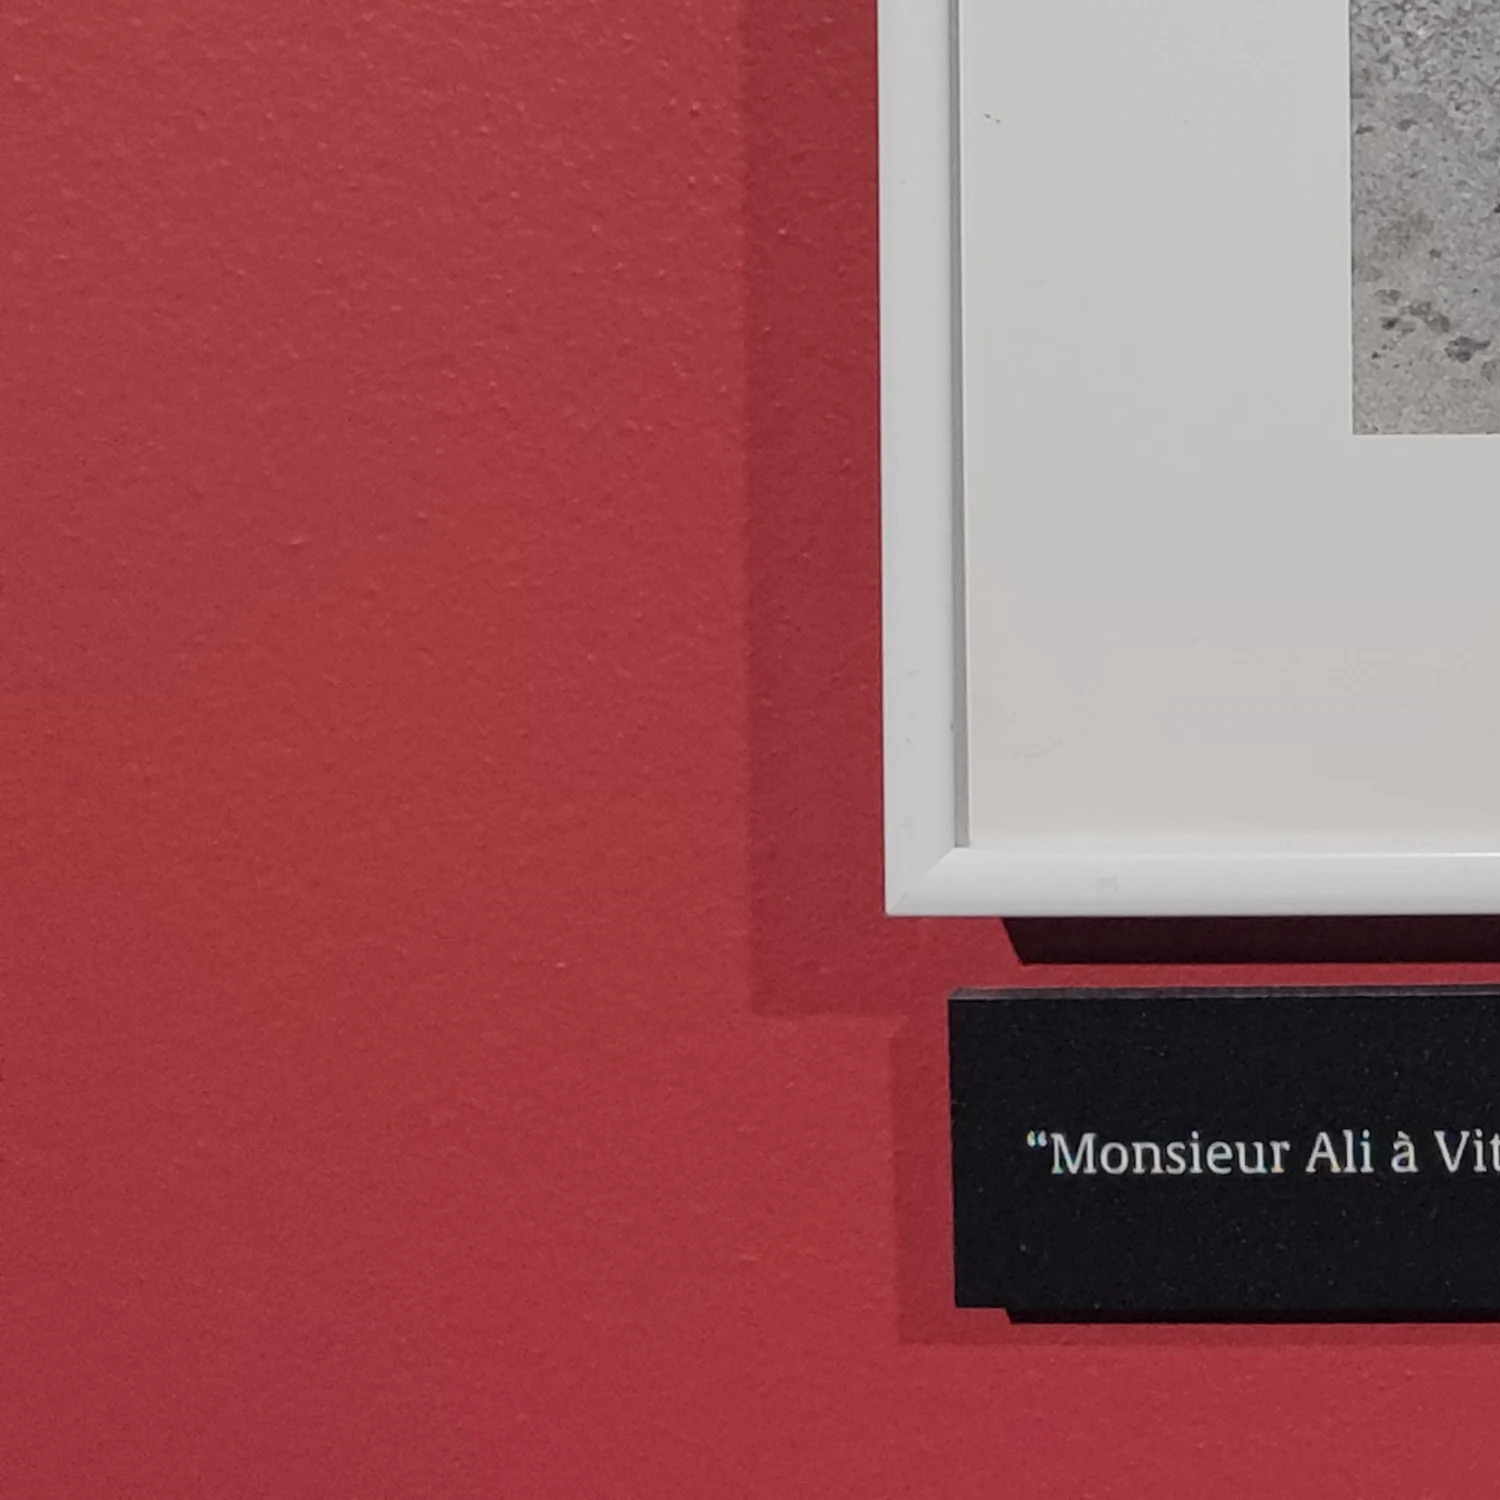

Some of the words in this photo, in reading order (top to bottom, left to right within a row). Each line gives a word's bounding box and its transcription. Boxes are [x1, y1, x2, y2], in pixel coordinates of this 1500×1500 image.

[1026, 1130, 1291, 1176] “Monsieur
[1305, 1129, 1376, 1175] Ali
[1390, 1129, 1419, 1174] à
